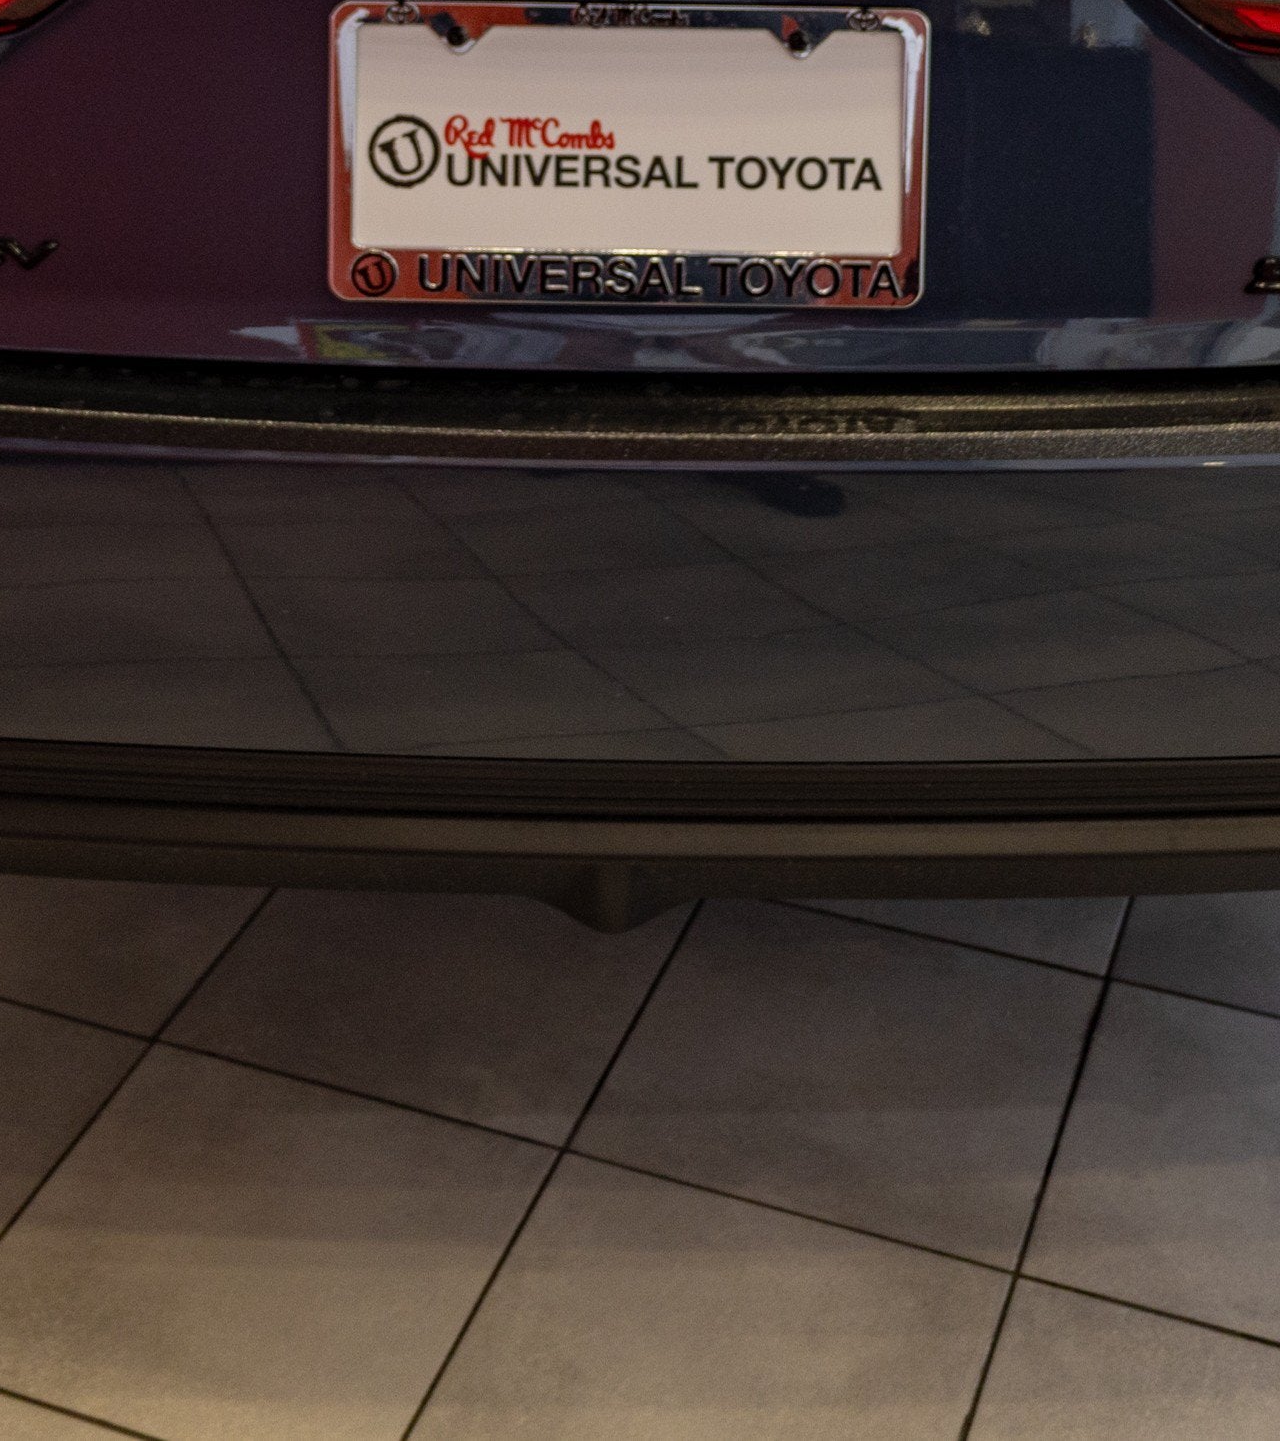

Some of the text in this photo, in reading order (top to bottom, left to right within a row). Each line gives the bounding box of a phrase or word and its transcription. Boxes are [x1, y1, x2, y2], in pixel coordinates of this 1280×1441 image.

[445, 114, 615, 157] Red McCombs
[446, 154, 883, 191] UNIVERSAL TOYOTA
[419, 254, 902, 300] UNIVERSAL TOYOTA
